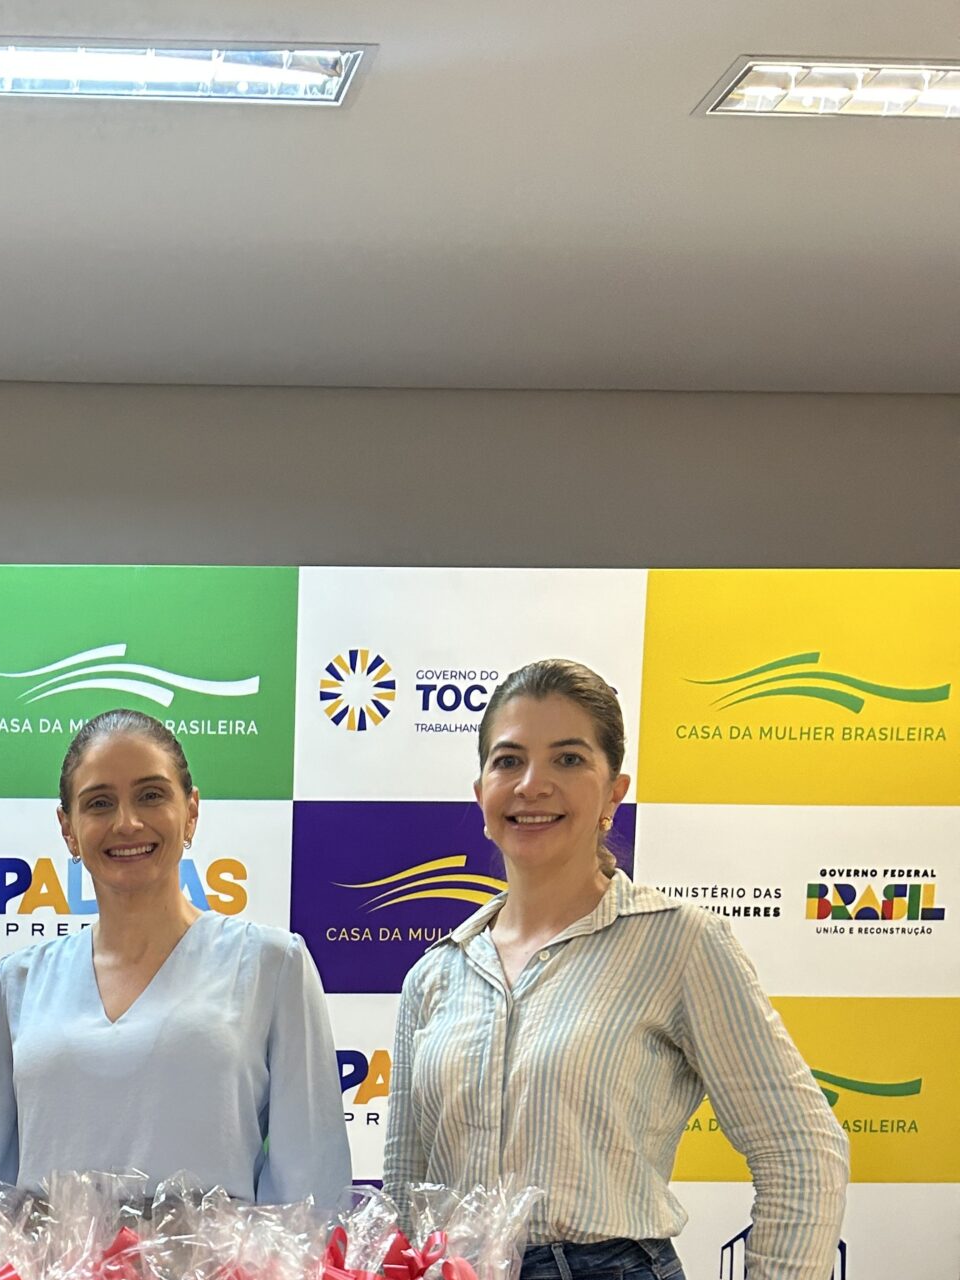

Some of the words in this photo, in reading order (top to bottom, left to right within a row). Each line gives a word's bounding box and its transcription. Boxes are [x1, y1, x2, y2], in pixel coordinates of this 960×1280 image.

[416, 670, 477, 681] GOVERNO
[480, 671, 499, 681] DO
[40, 718, 63, 733] DA
[164, 719, 259, 735] RASILEIRA
[415, 723, 481, 733] TRABALHAN
[676, 725, 722, 740] CASA
[729, 725, 752, 740] DA
[759, 726, 834, 741] MULHER
[842, 727, 947, 741] BRASILEIRA
[819, 868, 878, 878] GOVERNO
[883, 869, 937, 878] FEDERAL
[753, 888, 782, 899] DAS
[805, 883, 945, 921] BRASIL
[326, 928, 373, 941] CASA
[379, 928, 402, 941] DA
[816, 924, 845, 935] UNIÃO
[849, 927, 854, 935] E
[858, 926, 933, 937] RECONSTRUÇÃO
[842, 1119, 919, 1133] ASILEIRA
